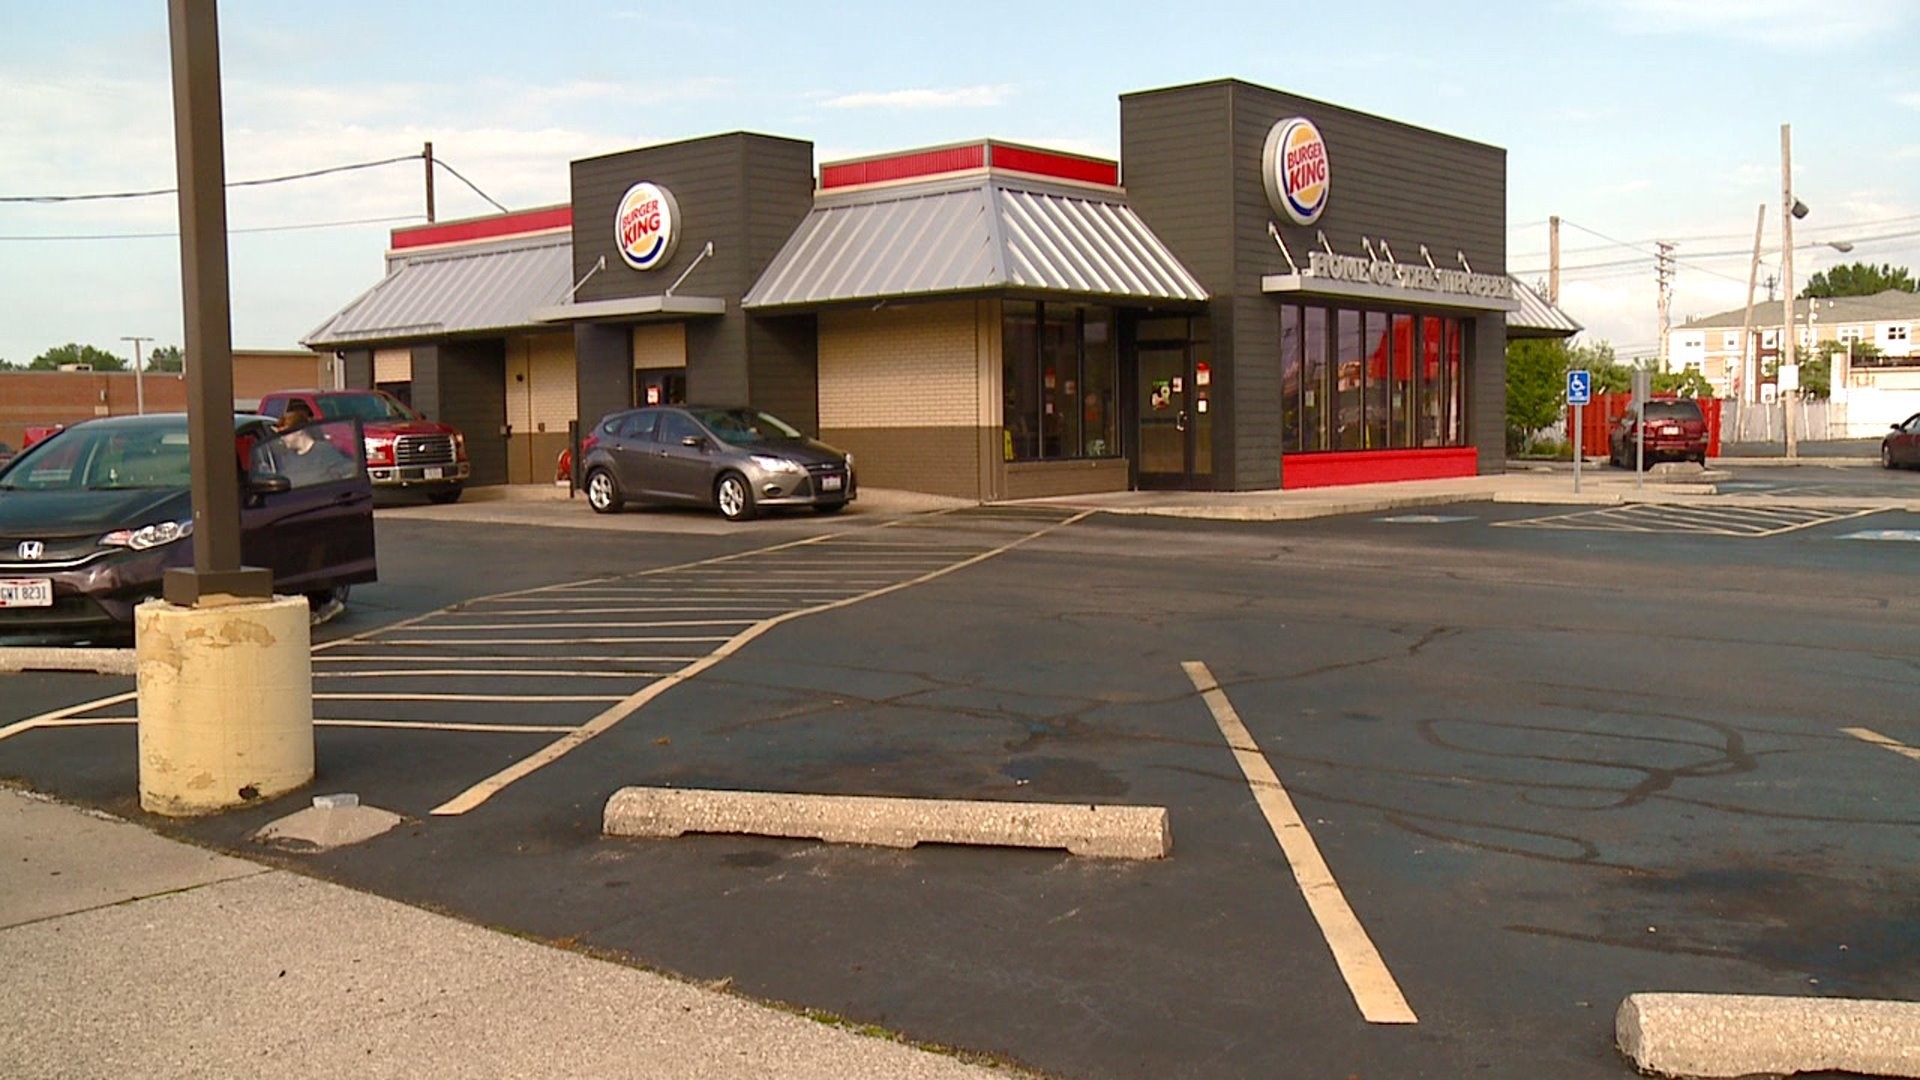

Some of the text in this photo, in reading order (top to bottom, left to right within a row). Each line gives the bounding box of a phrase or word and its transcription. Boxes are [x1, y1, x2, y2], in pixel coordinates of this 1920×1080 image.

[1287, 142, 1323, 169] BURGER
[1289, 158, 1325, 194] KING
[623, 199, 659, 227] BURGER
[623, 212, 661, 248] KING
[1309, 251, 1370, 283] HOME
